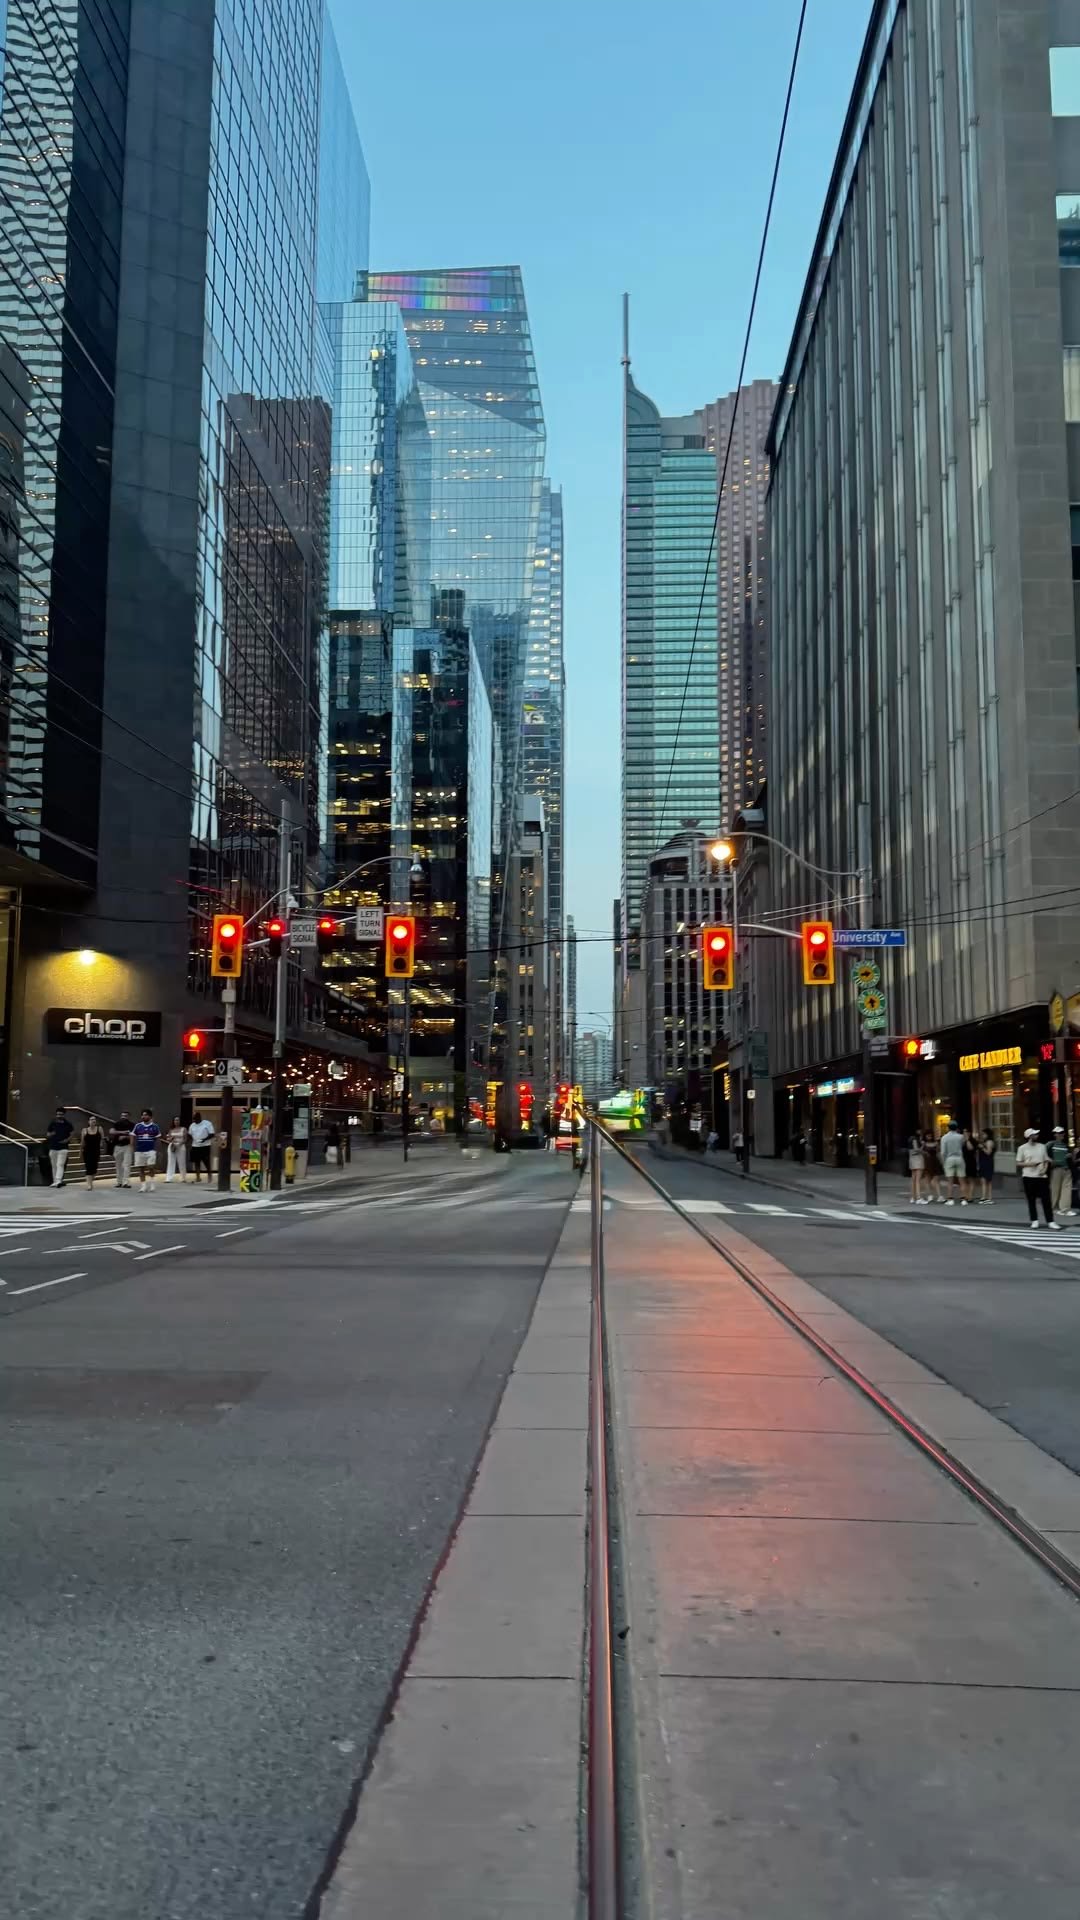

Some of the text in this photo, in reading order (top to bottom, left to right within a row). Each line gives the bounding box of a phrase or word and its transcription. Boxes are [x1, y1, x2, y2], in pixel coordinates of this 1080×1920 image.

[360, 910, 380, 918] LEFT
[360, 919, 381, 928] TURN
[359, 929, 381, 937] SIGNAL
[293, 934, 315, 943] SIGNAL
[832, 931, 888, 945] University
[64, 1012, 147, 1040] chop
